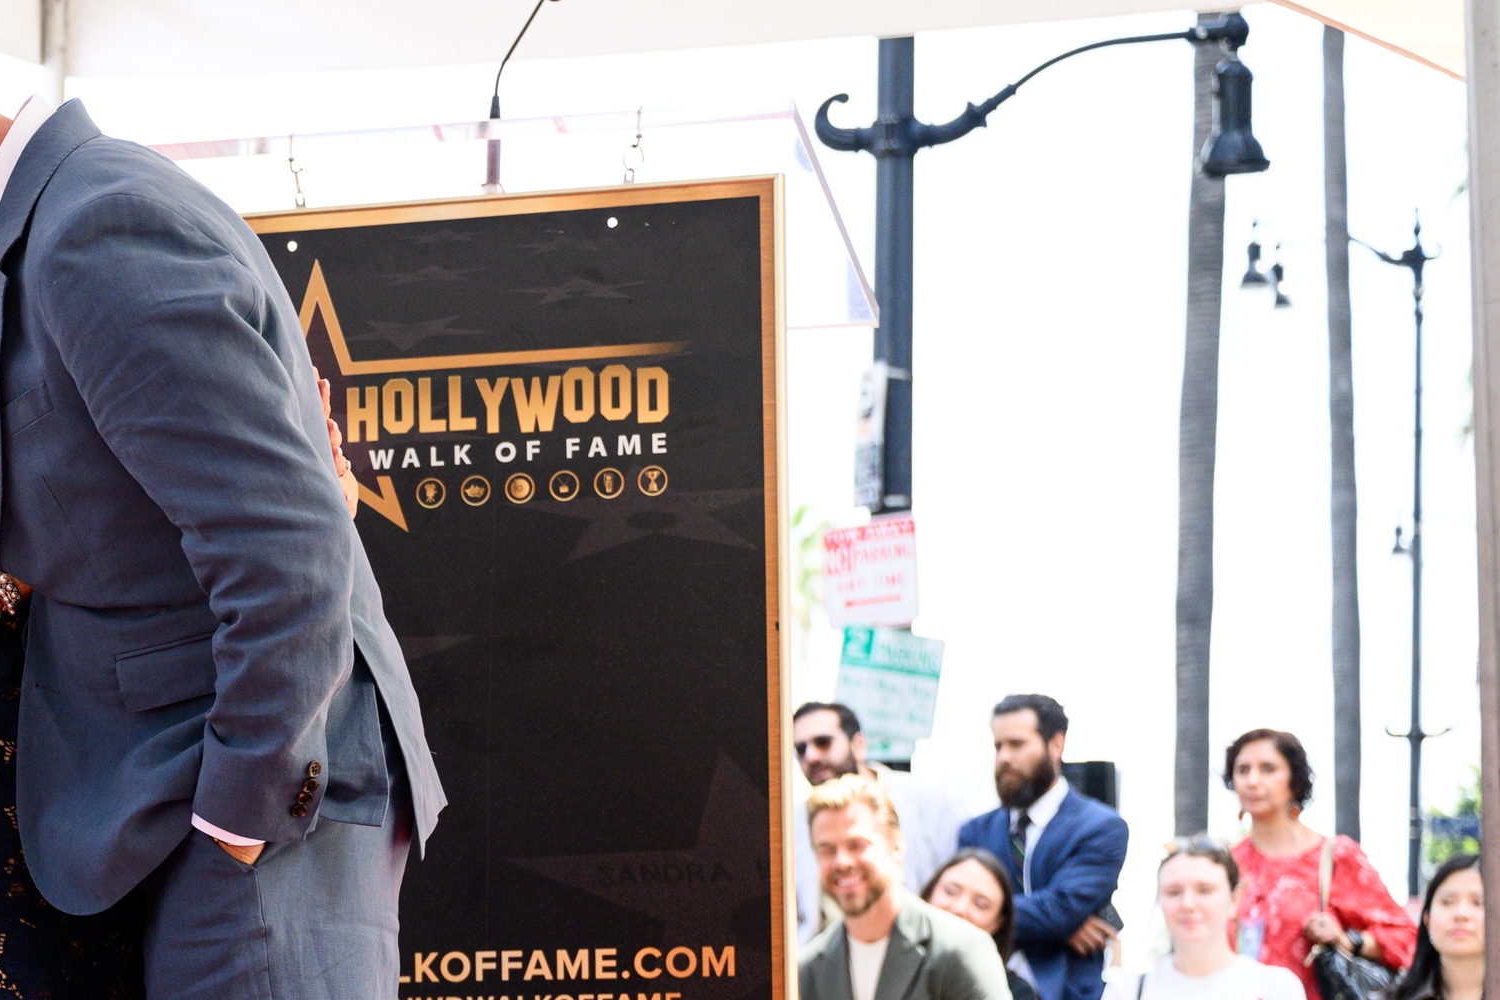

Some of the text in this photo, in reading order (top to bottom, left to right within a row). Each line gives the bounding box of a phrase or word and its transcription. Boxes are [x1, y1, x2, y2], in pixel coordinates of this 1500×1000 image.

[346, 364, 669, 443] HOLLYWOOD
[369, 433, 667, 470] WALK OF FAME
[827, 544, 911, 576] NO PARKING
[597, 862, 732, 887] SANDRA
[399, 945, 736, 984] KOFFAME.COM
